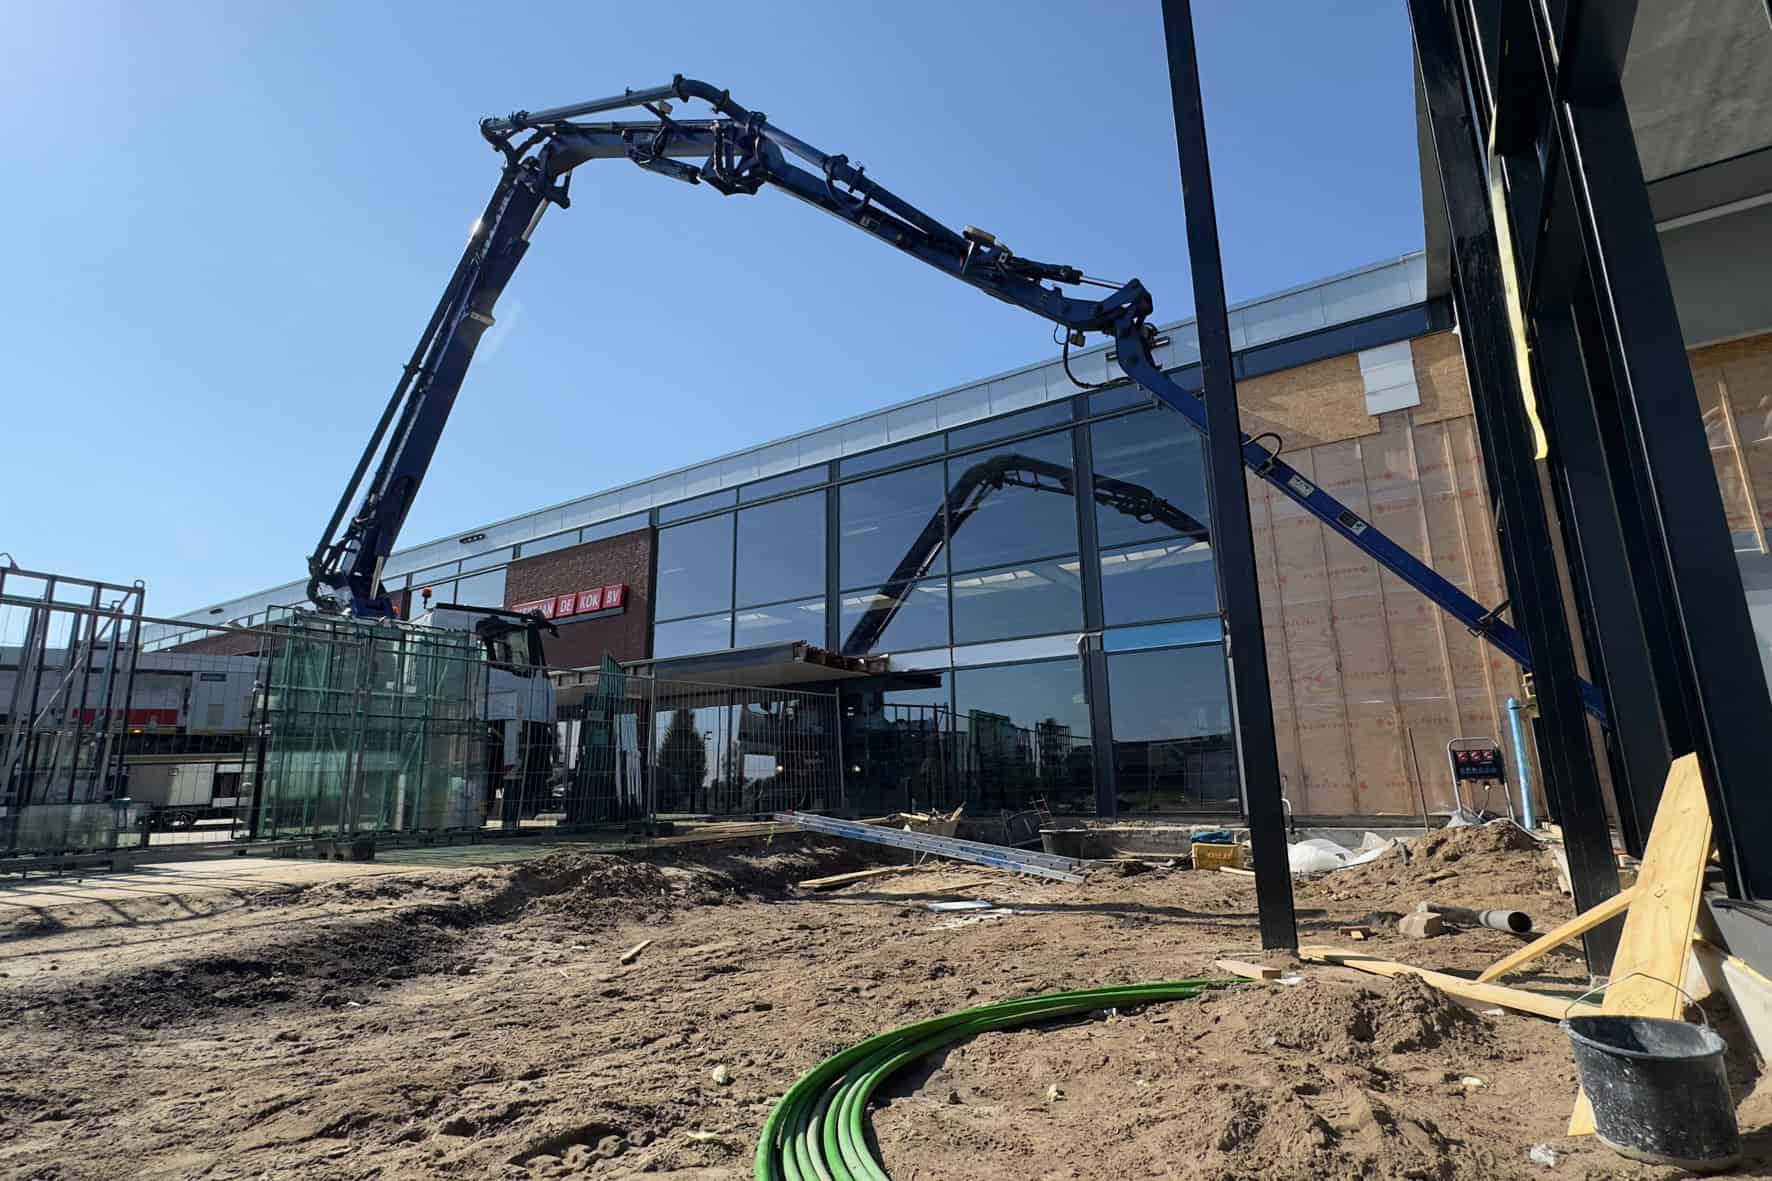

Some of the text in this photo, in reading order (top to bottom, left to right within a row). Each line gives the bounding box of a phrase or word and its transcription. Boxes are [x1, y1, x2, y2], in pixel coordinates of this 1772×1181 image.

[560, 599, 573, 613] DE
[579, 594, 599, 609] KOK
[606, 590, 618, 604] BV
